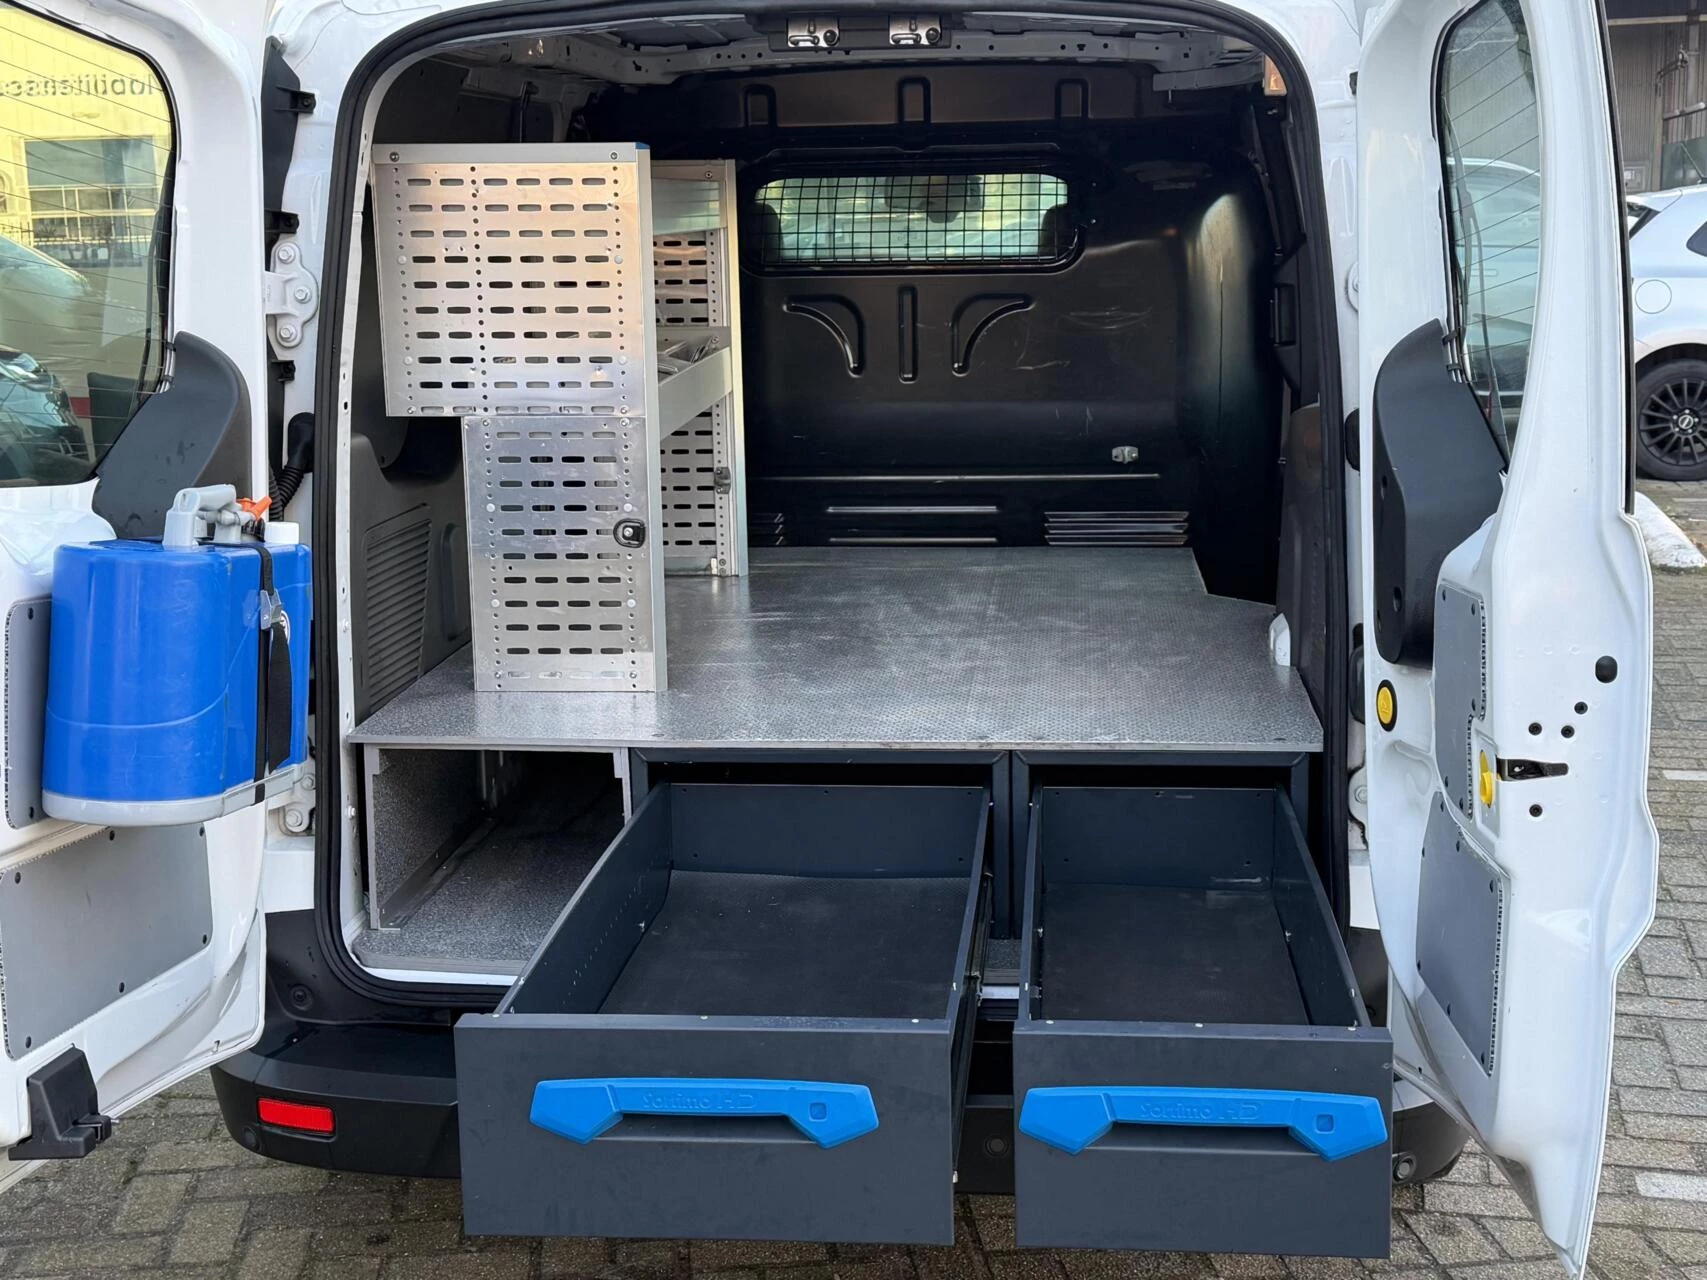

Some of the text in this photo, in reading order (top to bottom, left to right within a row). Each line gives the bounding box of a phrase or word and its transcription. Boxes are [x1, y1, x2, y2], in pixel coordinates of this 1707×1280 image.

[641, 1093, 757, 1109] Sortimo HD
[1140, 1103, 1260, 1120] Sortimo HD
